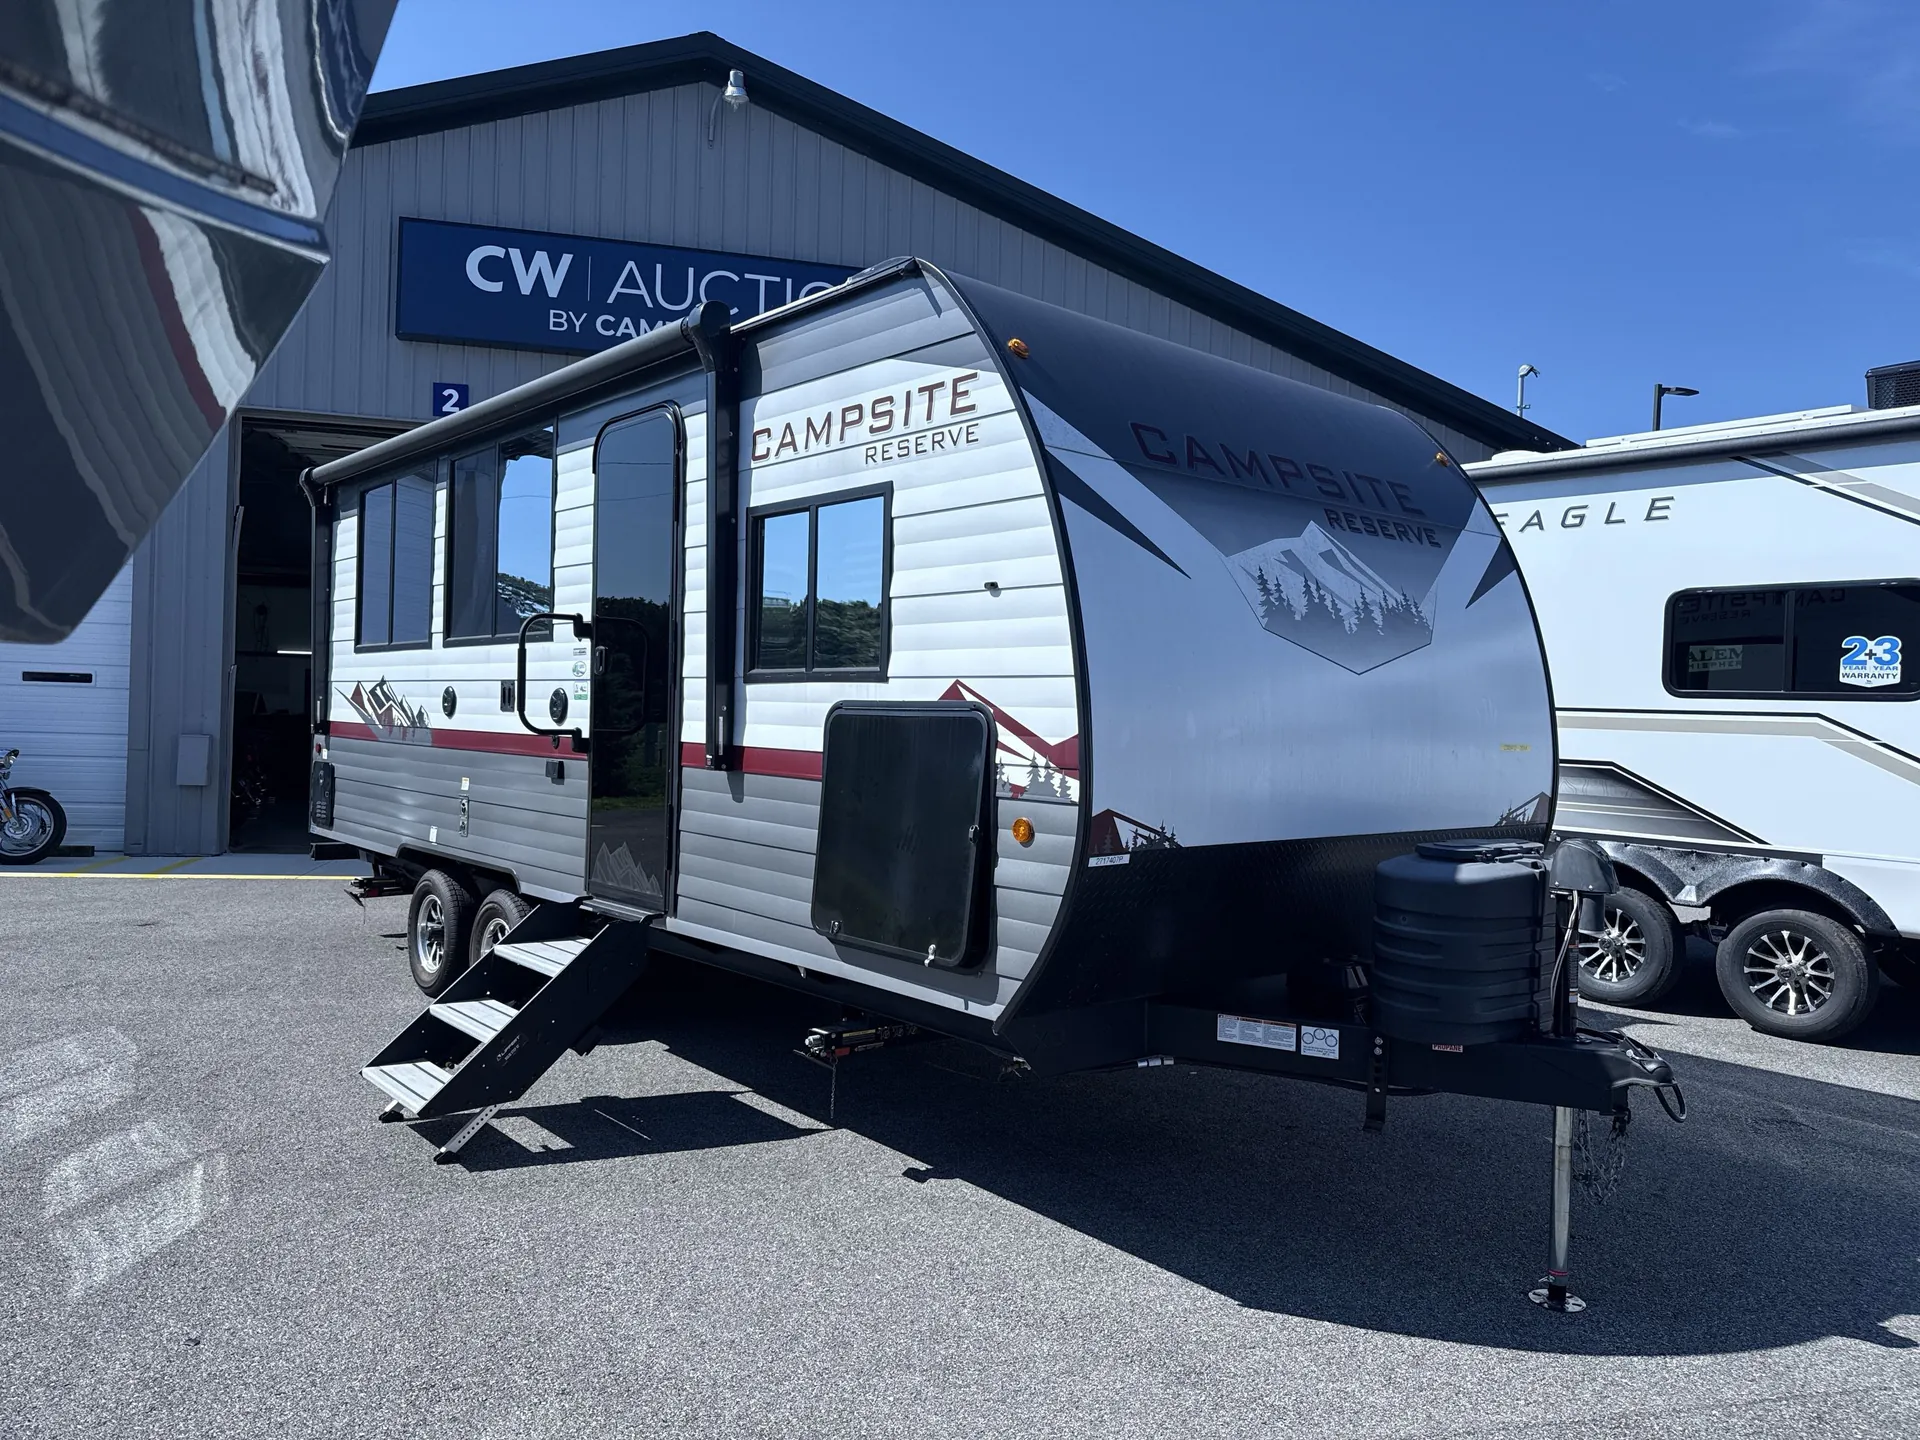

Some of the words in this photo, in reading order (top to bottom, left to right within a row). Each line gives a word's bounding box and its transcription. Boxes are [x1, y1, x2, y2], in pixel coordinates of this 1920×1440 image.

[465, 245, 573, 298] CW
[549, 309, 588, 333] BY
[595, 314, 678, 339] CAM
[442, 388, 460, 413] 2
[751, 370, 979, 462] CAMPSITE
[864, 422, 980, 465] RESERVE
[1128, 420, 1426, 516] CAMPSITE
[1323, 507, 1442, 549] RESERVE
